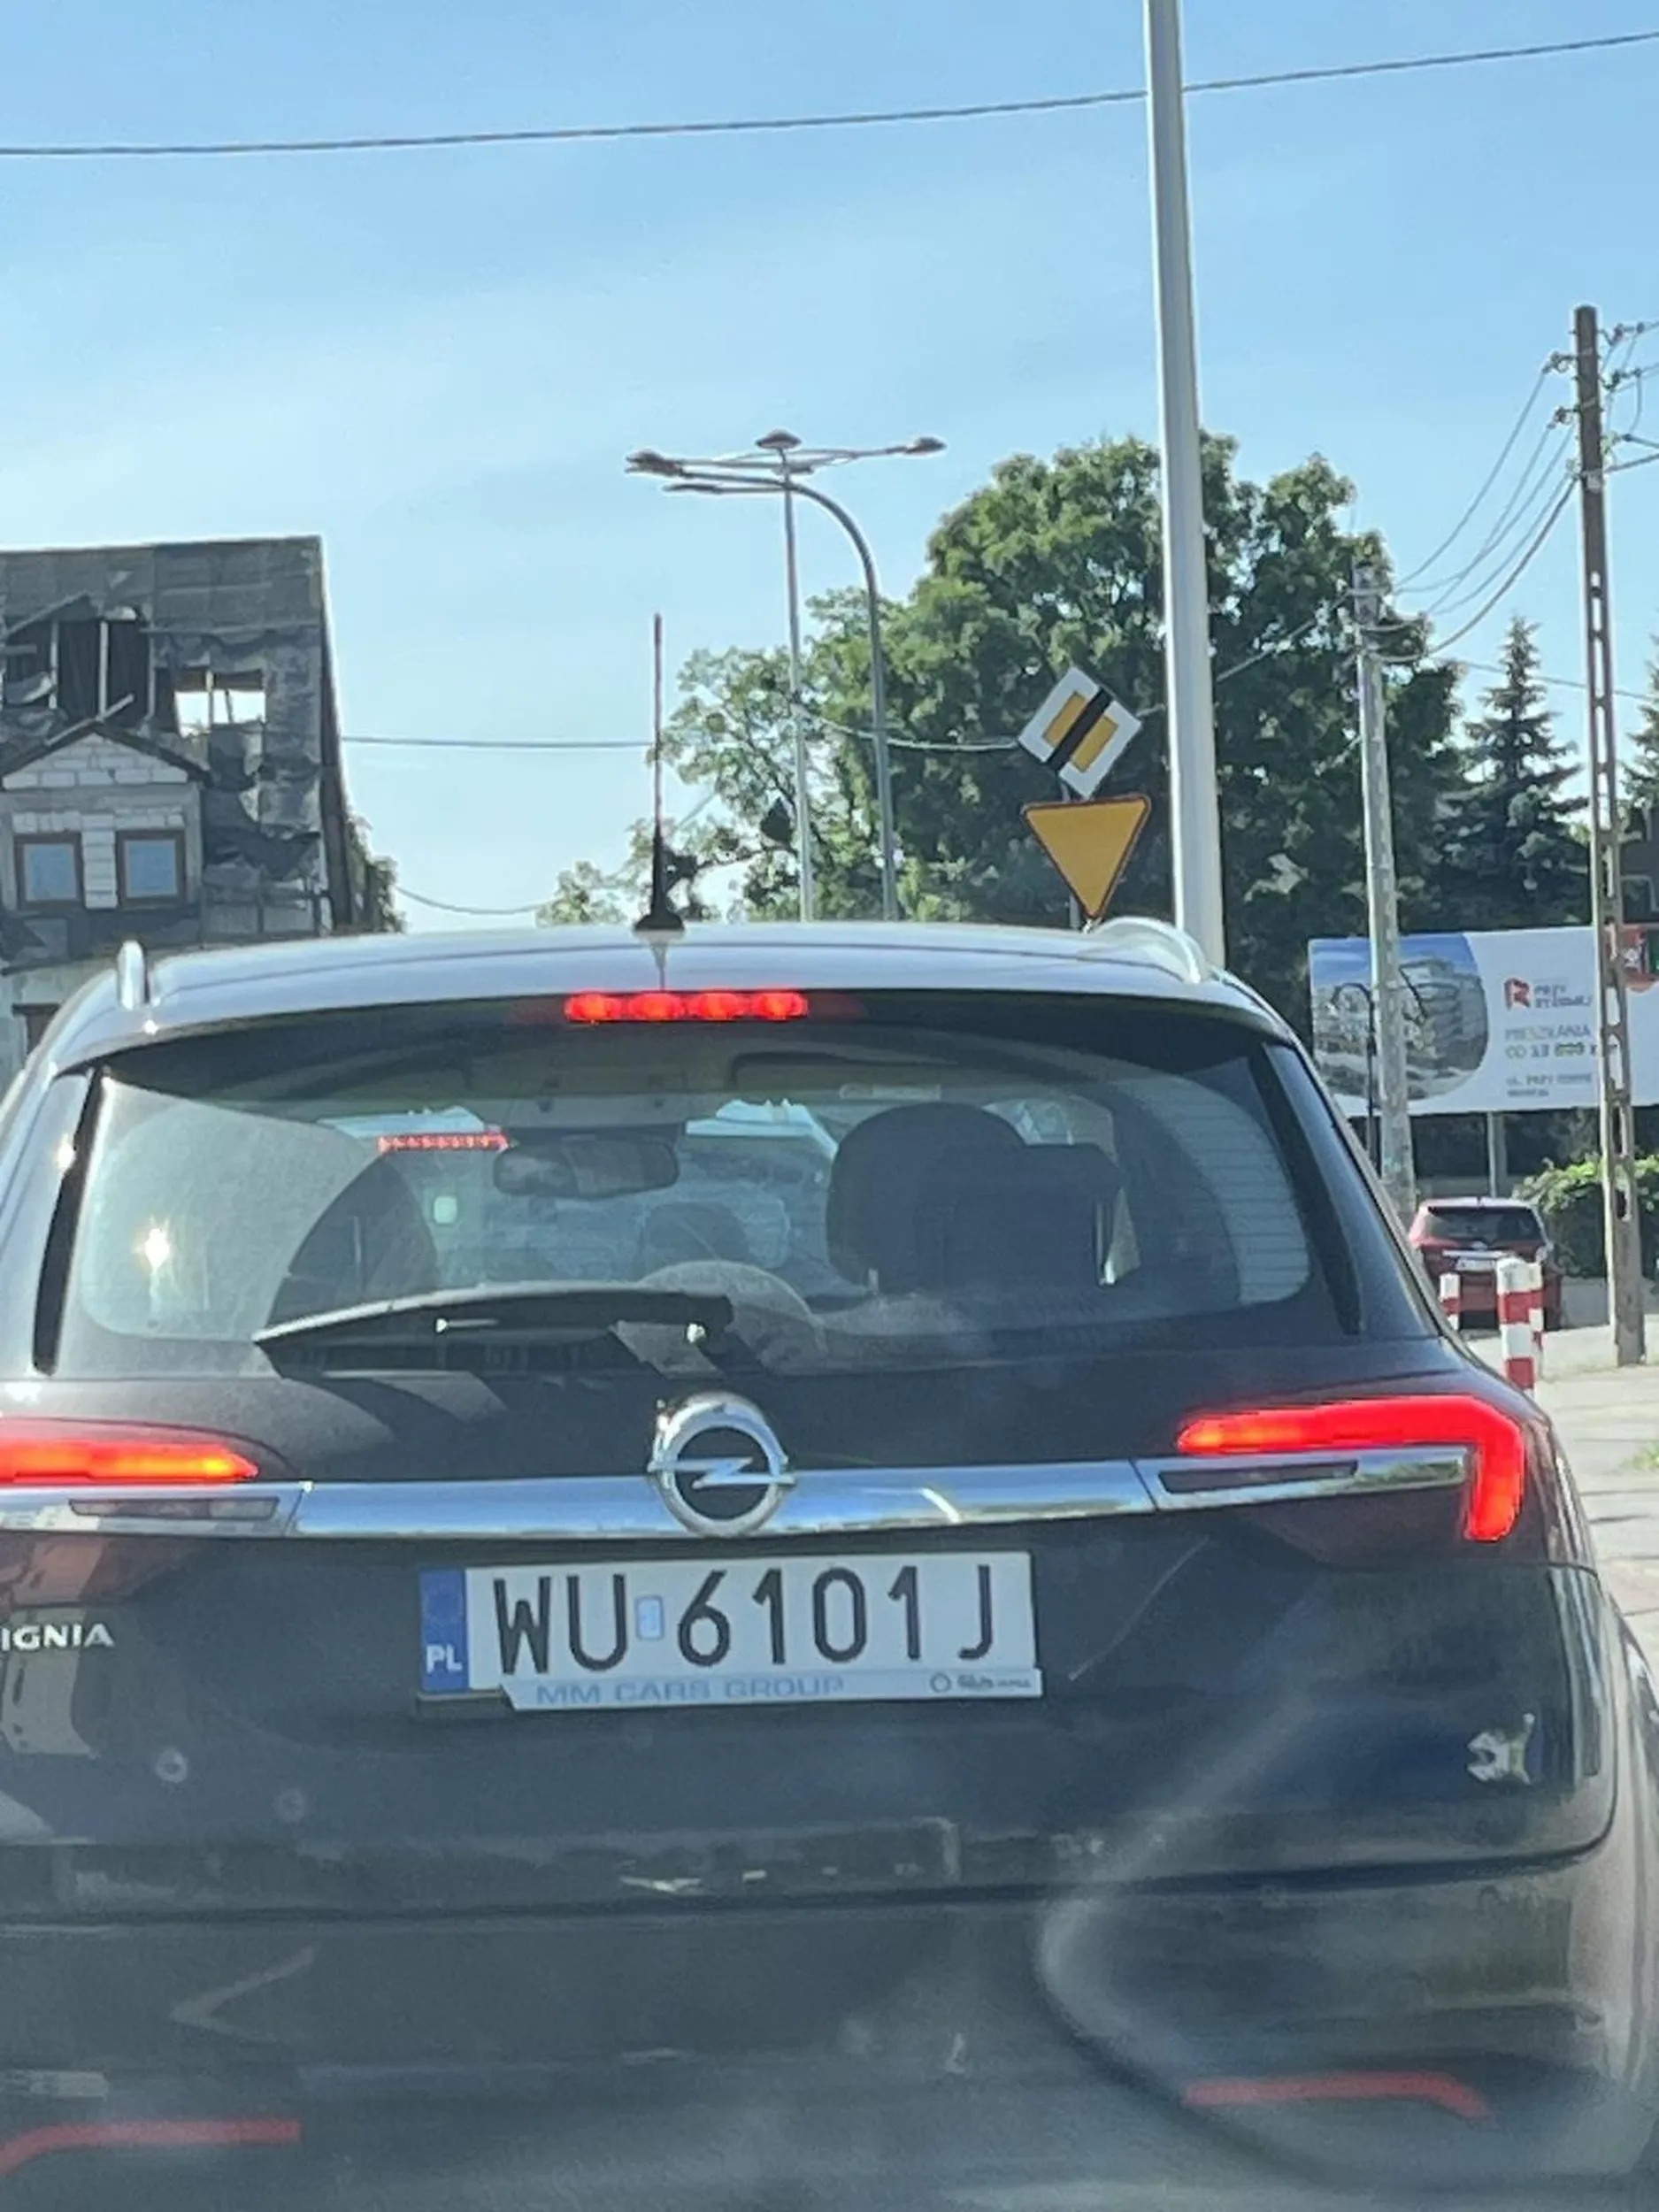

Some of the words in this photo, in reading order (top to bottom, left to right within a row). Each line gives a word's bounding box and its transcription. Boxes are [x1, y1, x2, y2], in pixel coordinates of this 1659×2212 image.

[493, 1573, 629, 1675] WU
[677, 1564, 994, 1668] 6101J
[426, 1644, 463, 1673] PL
[535, 1683, 601, 1704] MM
[614, 1679, 710, 1701] CARS
[724, 1675, 845, 1698] GROUP
